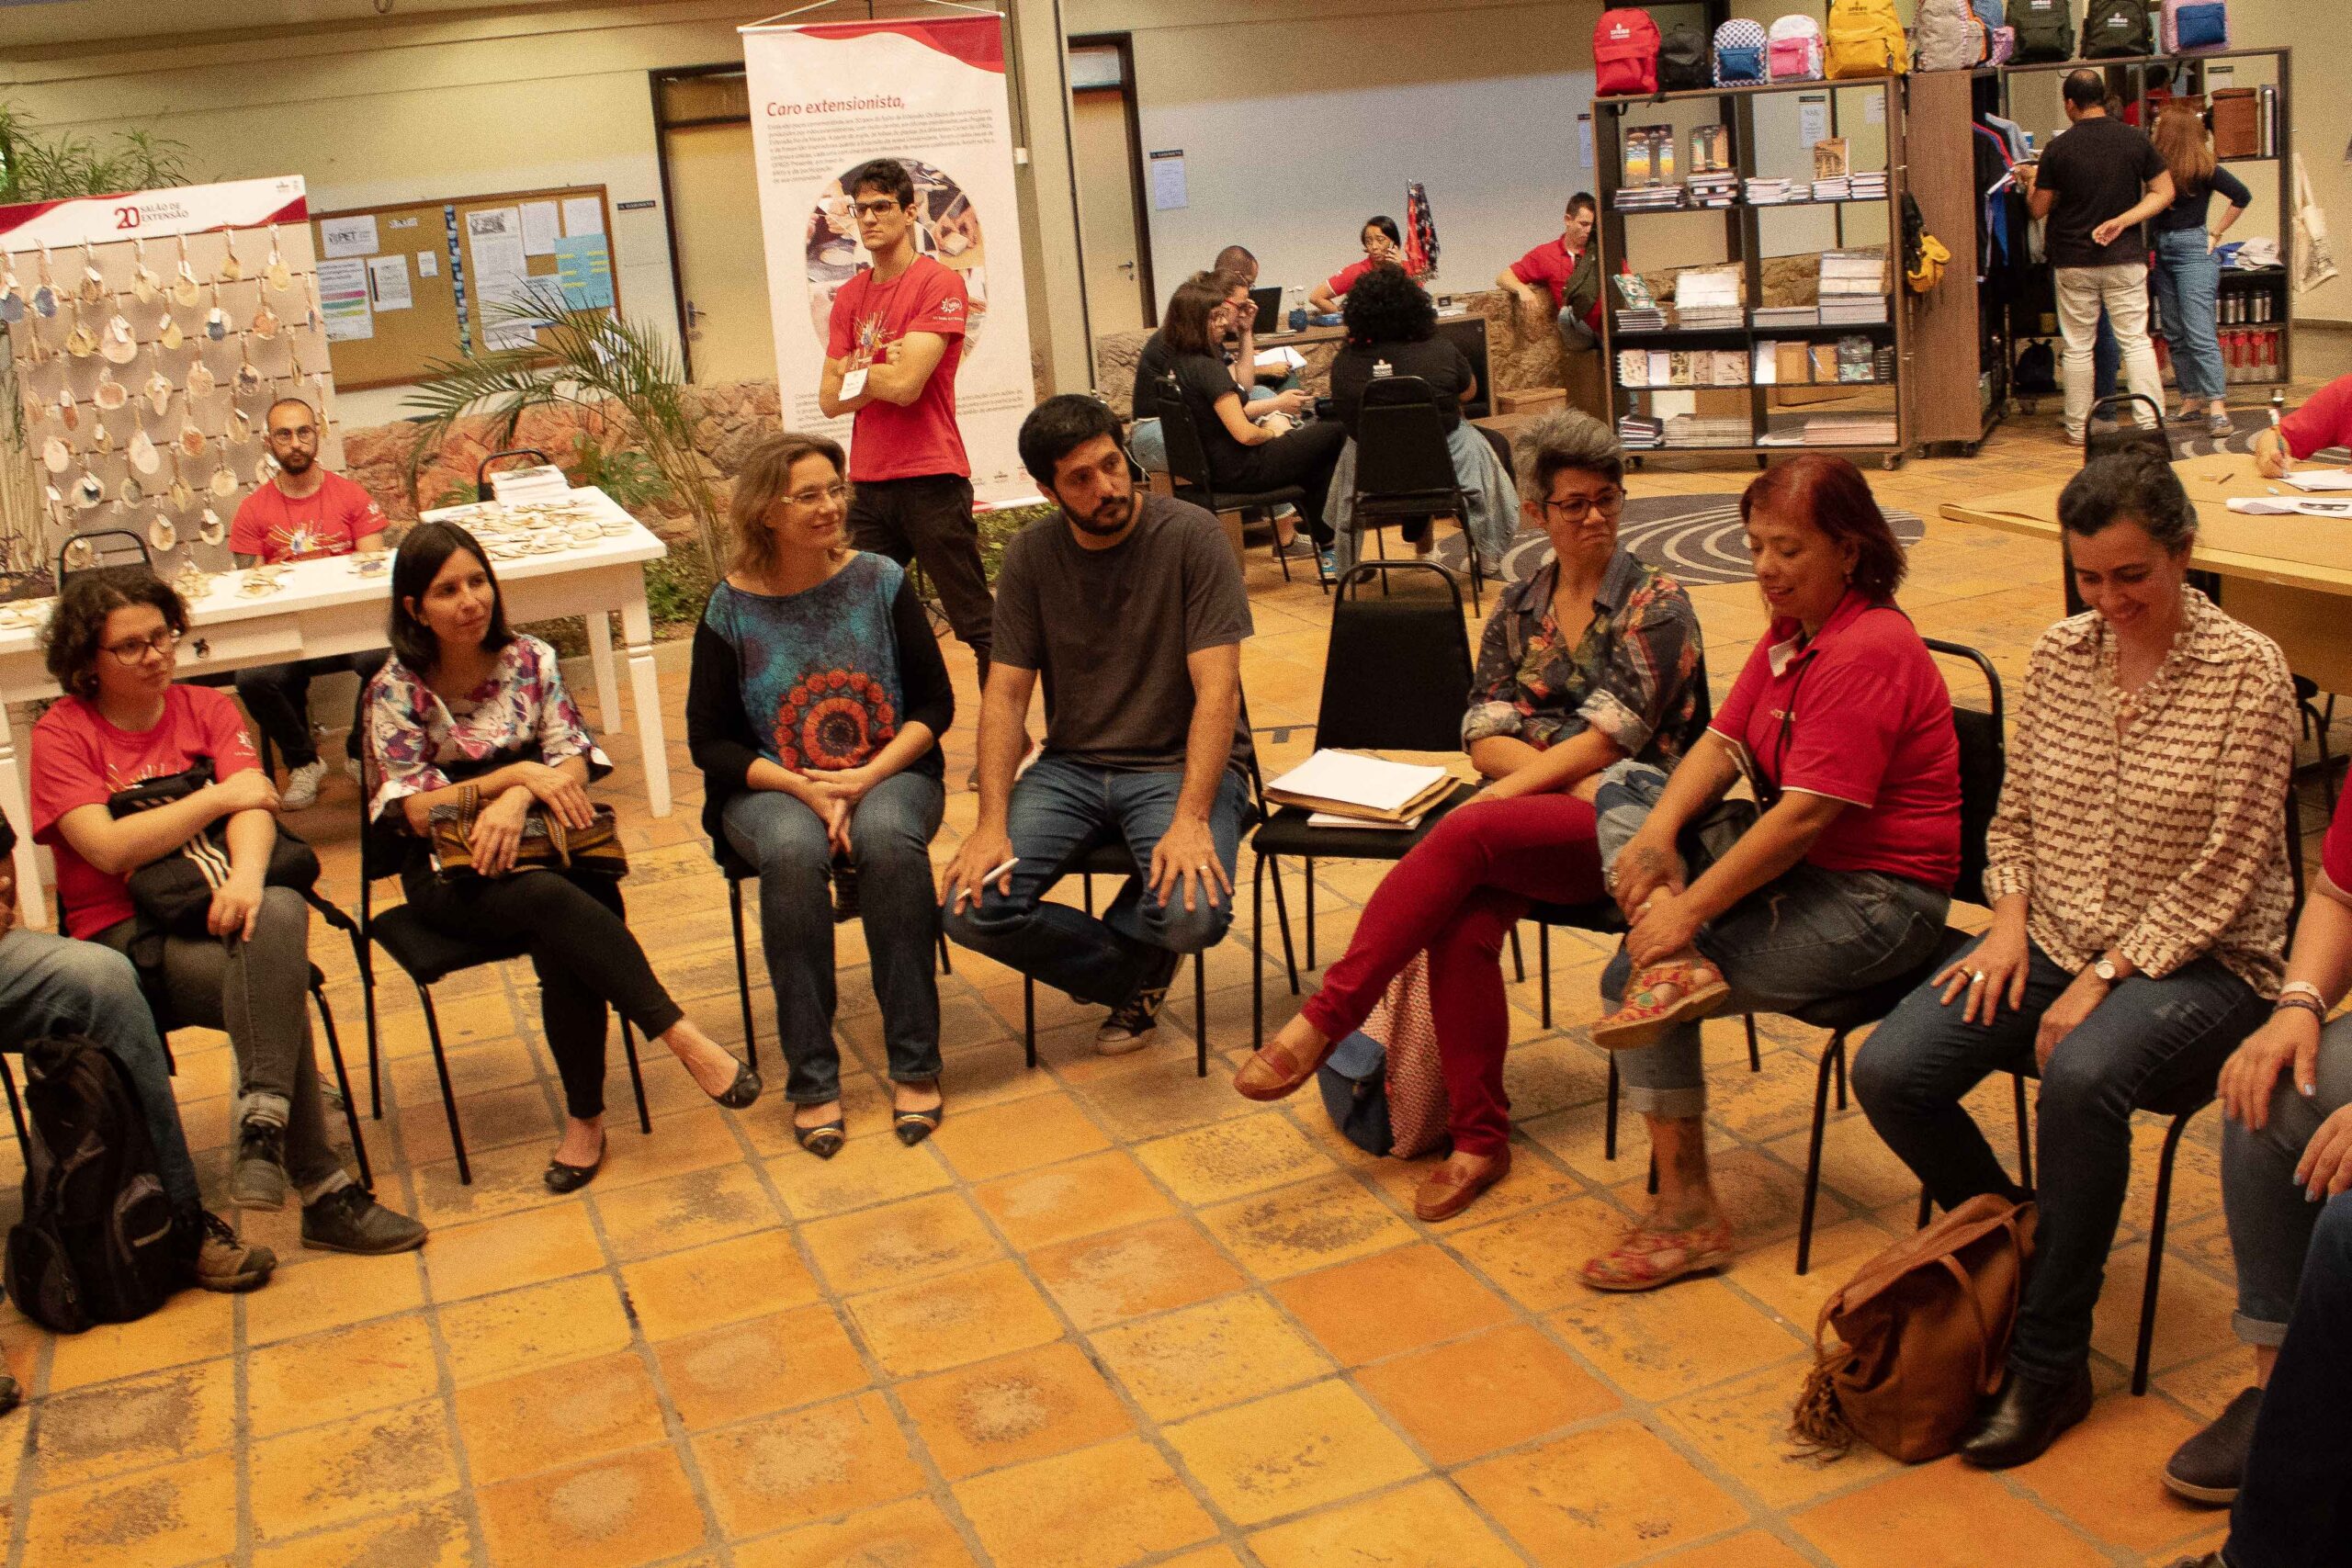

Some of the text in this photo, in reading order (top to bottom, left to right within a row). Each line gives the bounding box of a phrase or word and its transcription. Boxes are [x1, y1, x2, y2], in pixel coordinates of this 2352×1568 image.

[767, 95, 905, 117] Caro extensionista,
[114, 206, 141, 230] 20
[141, 210, 189, 221] EXTENSÃO
